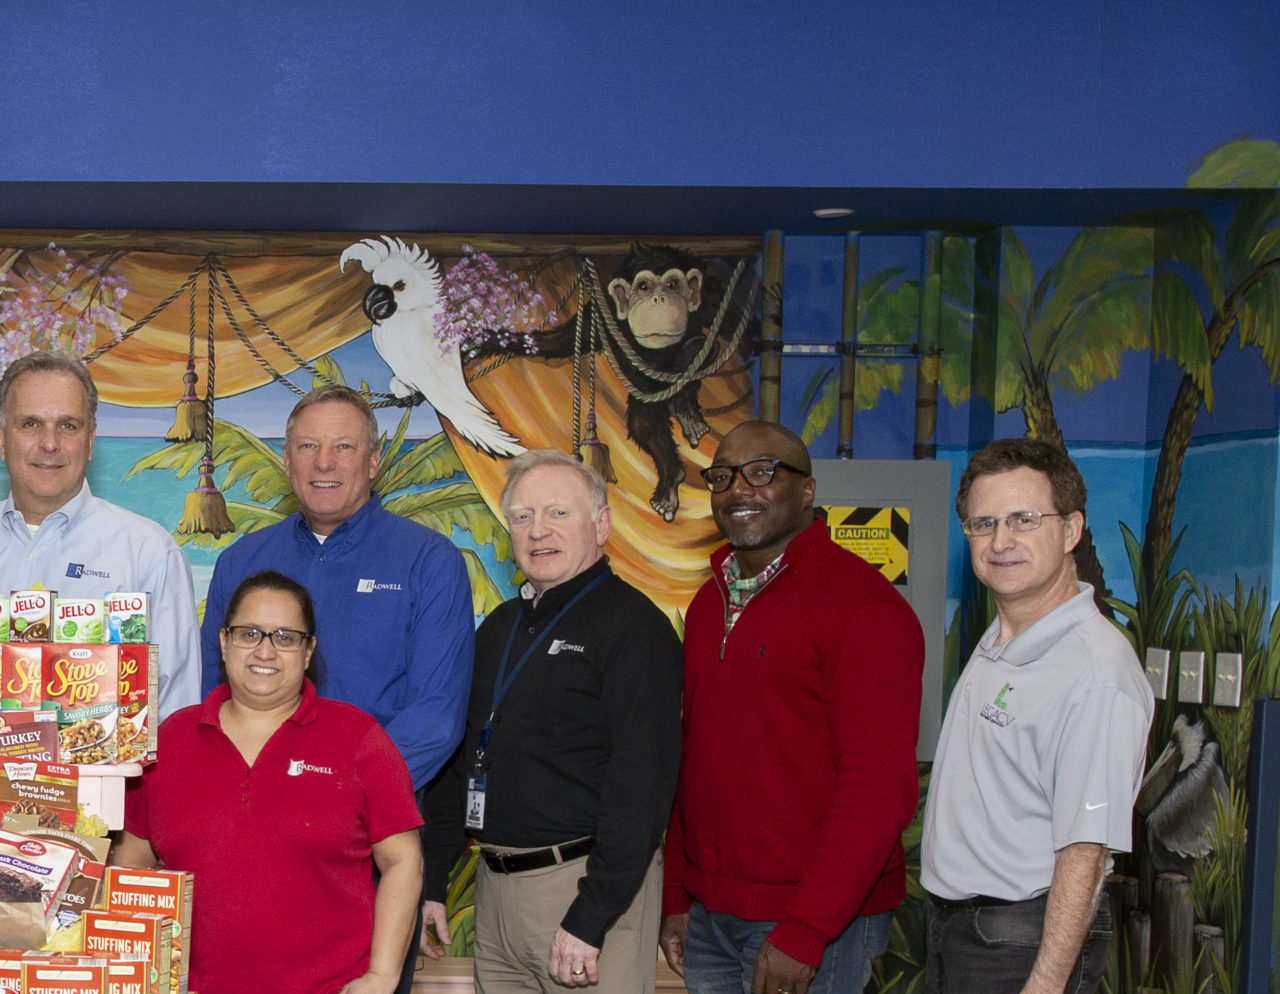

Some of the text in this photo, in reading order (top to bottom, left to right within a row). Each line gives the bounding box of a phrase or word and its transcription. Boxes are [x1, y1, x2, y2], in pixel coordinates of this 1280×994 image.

[837, 529, 887, 539] CAUTION
[74, 565, 111, 579] RADWELL
[365, 580, 402, 591] RADWELL
[13, 596, 46, 613] JELL-O
[59, 603, 95, 619] JELL-O
[47, 659, 108, 696] Stove
[91, 704, 113, 715] HERBS
[47, 765, 70, 774] EXTRA
[296, 761, 333, 775] RADWELL
[11, 783, 65, 797] chewy fudge
[18, 790, 58, 802] brownies
[14, 859, 50, 876] Chocolate
[111, 891, 176, 909] STUFFING MIX
[87, 936, 151, 954] STUFFING MIX
